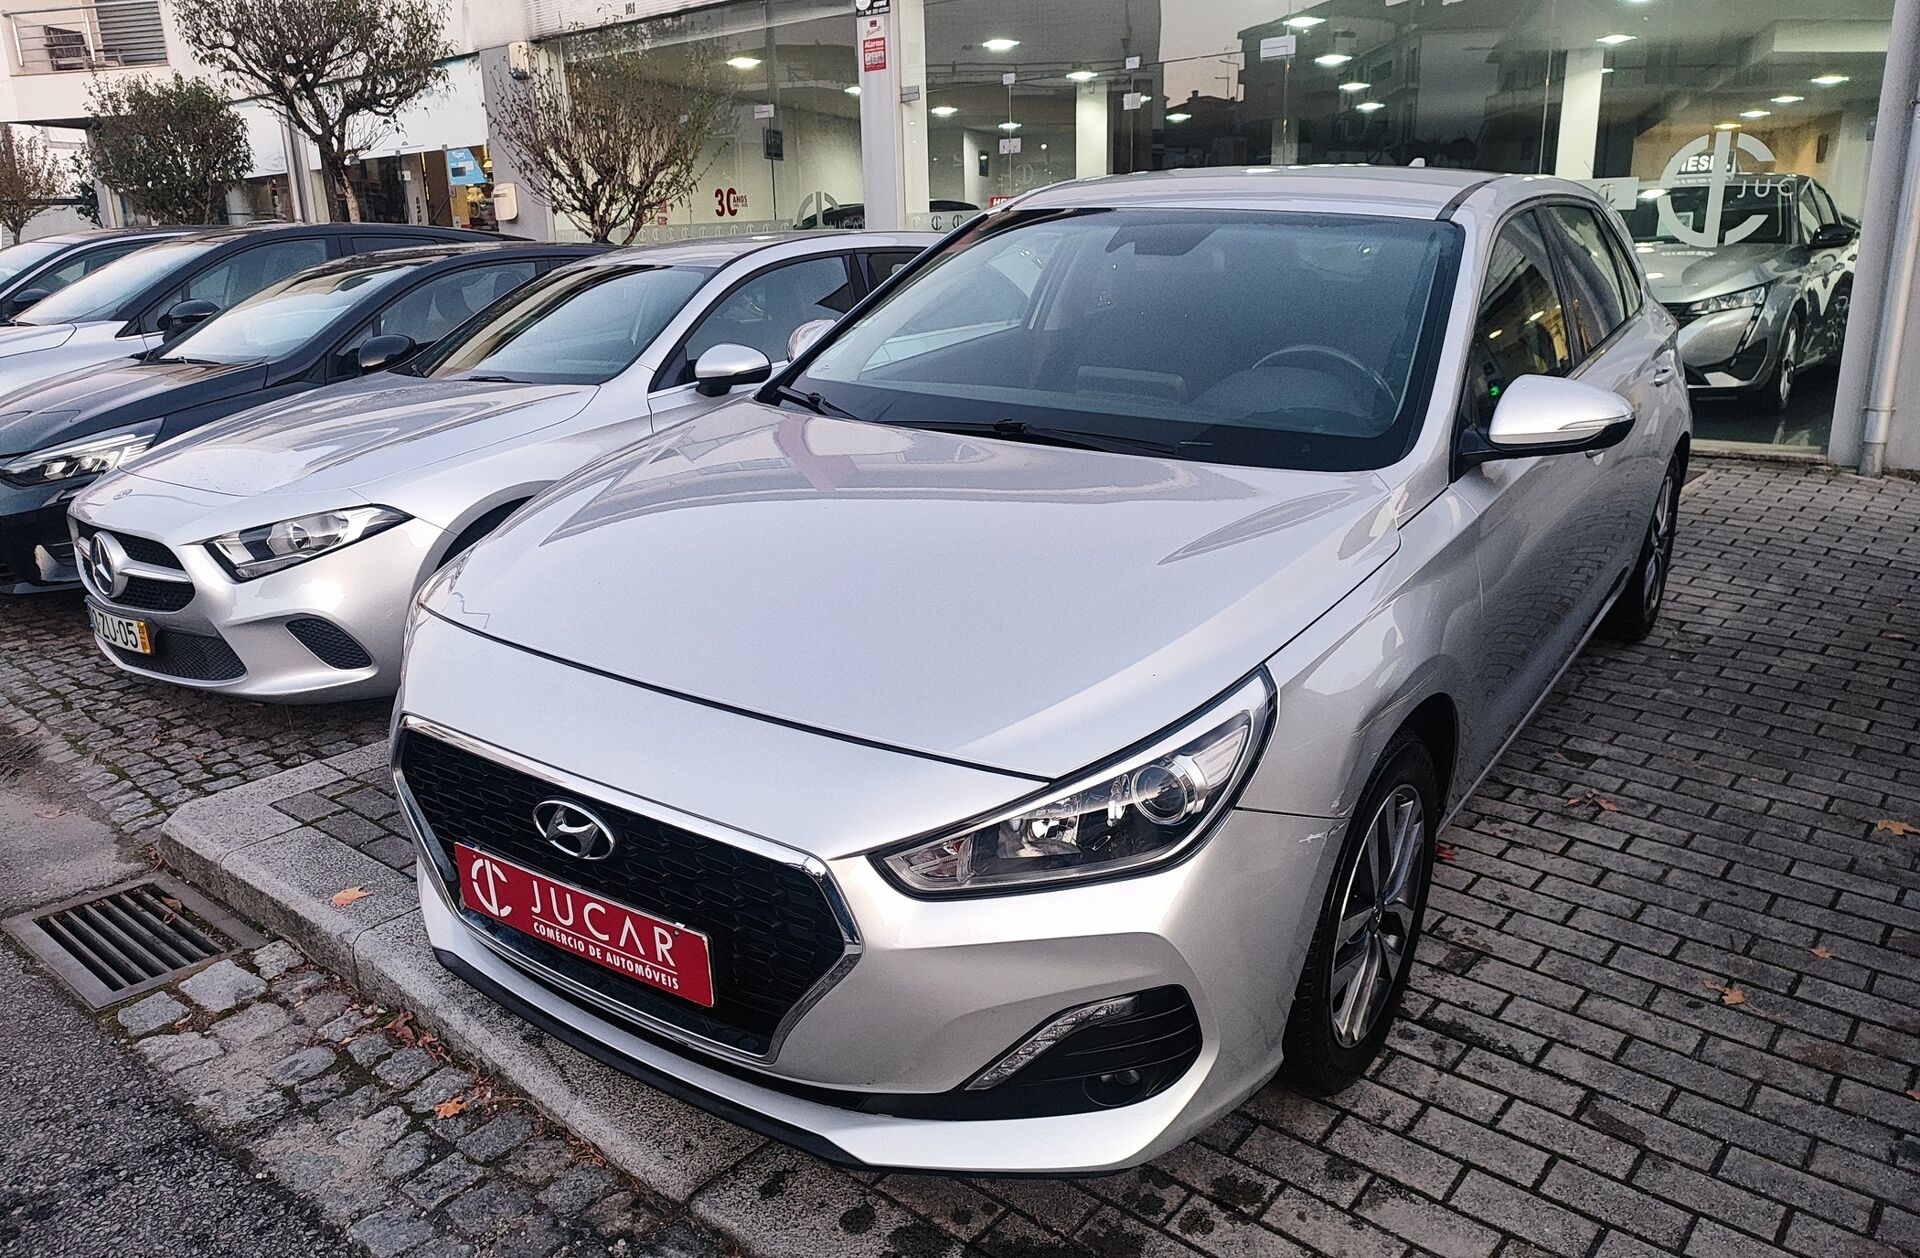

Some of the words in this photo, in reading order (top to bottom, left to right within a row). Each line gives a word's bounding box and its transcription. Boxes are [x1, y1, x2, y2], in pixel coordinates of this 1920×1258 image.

[531, 880, 676, 967] JUCAR
[533, 921, 585, 953] COMÉRCIO
[589, 945, 602, 960] DE
[606, 952, 679, 990] AUTOMÓVEIS
